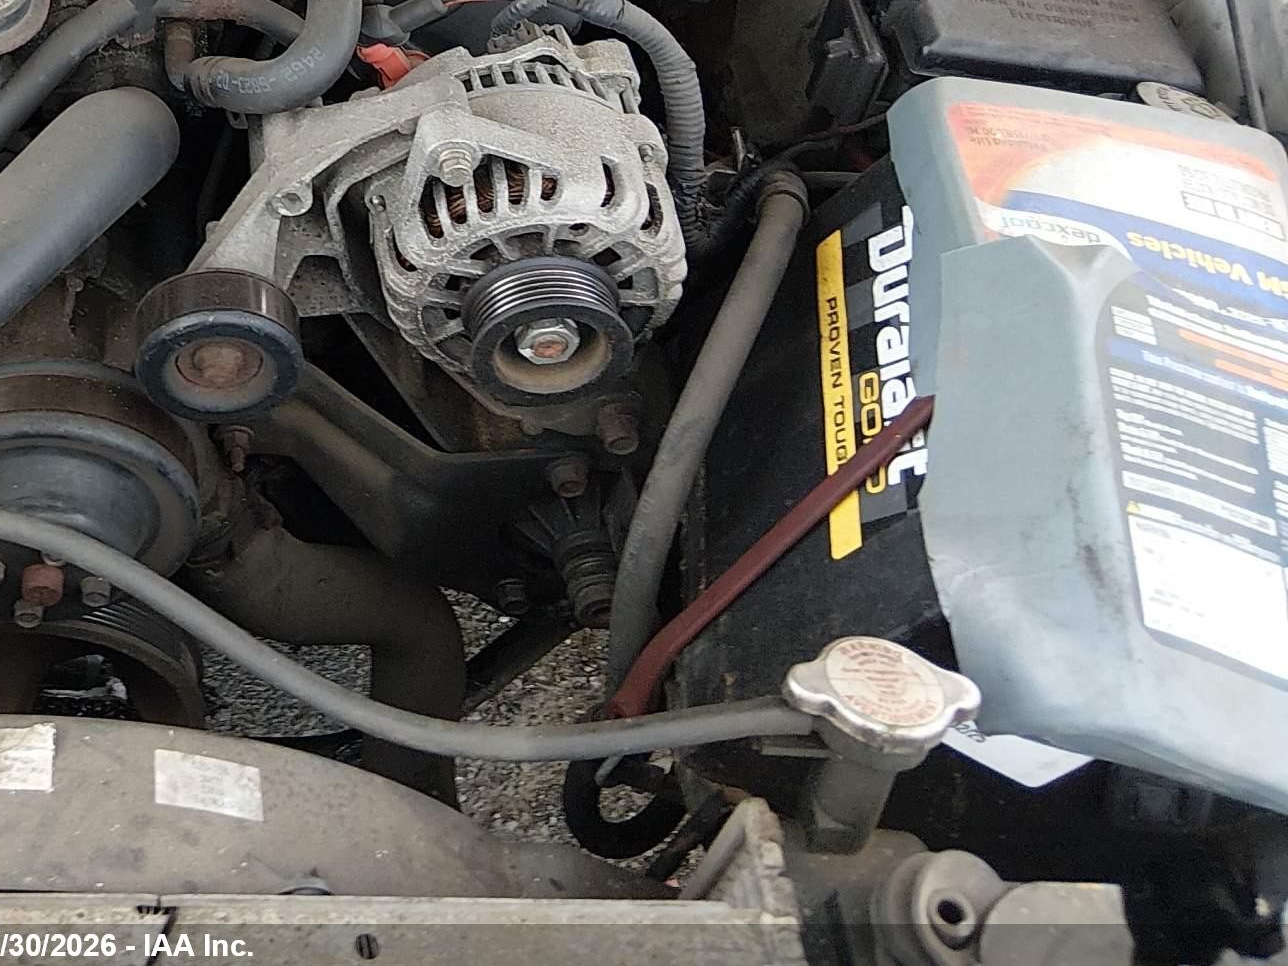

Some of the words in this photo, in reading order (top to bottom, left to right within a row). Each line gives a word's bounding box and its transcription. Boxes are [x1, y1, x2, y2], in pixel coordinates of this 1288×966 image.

[1126, 230, 1254, 286] Vehicles
[825, 295, 843, 389] PROVEN
[832, 395, 850, 461] TOUG
